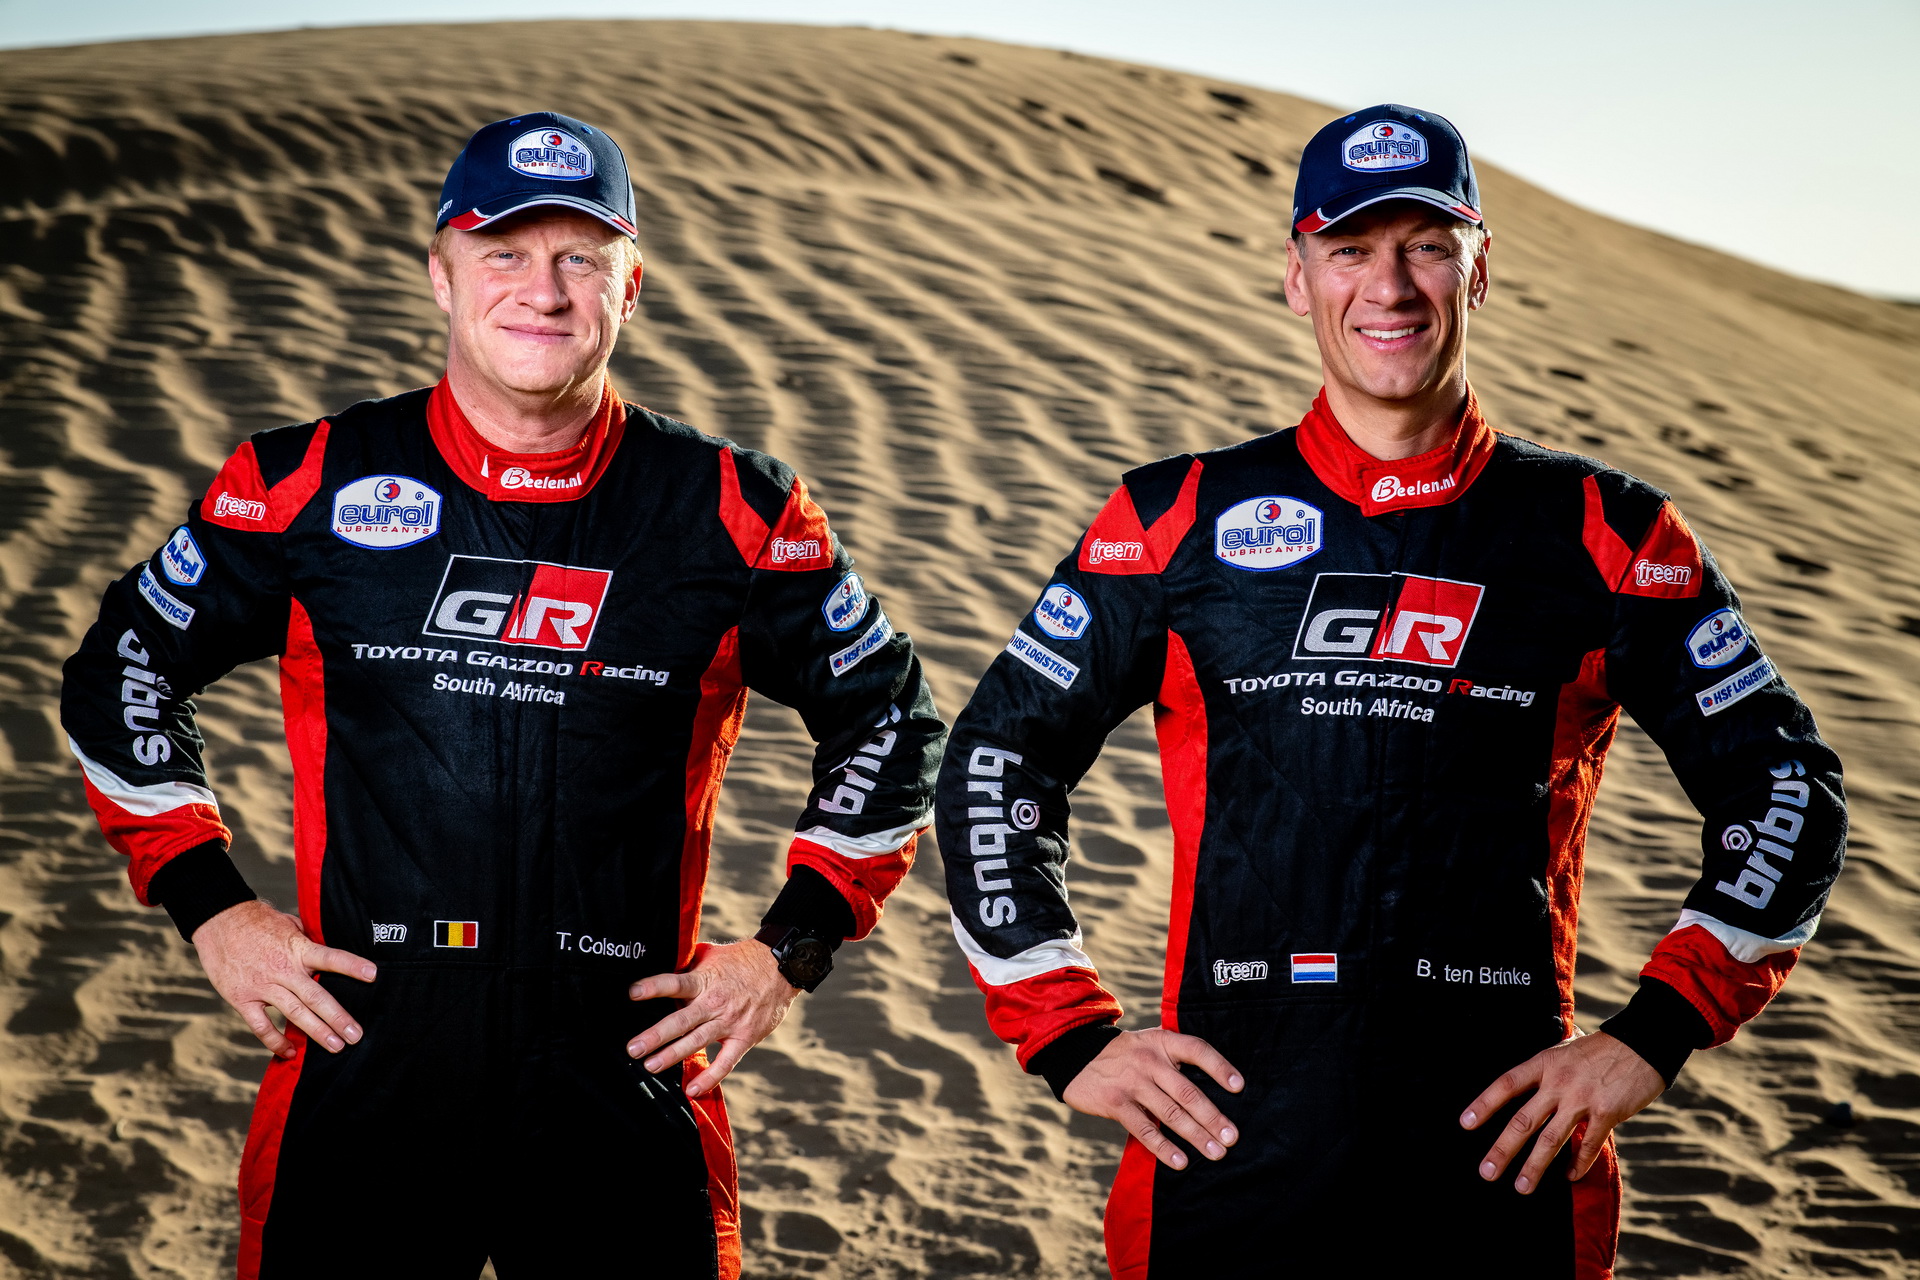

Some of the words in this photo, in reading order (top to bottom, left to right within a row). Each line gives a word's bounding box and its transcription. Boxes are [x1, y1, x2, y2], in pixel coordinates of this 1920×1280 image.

[515, 147, 587, 170] eurol
[1348, 138, 1421, 160] eurol
[1349, 153, 1421, 166] LUBRICANTS
[516, 162, 587, 176] LUBRICANTS
[500, 467, 583, 489] Beelen.nl
[1371, 473, 1457, 502] Beelen.nl
[214, 491, 266, 521] freem
[338, 500, 433, 527] eurol
[336, 526, 431, 535] LUBRICANTS
[1221, 518, 1316, 549] eurol
[771, 537, 821, 563] freem
[1088, 538, 1144, 565] freem
[1220, 545, 1315, 558] LUBRICANTS
[1635, 559, 1692, 586] freem
[148, 584, 191, 623] LOGISTICS
[1040, 599, 1084, 633] eurol
[434, 590, 594, 645] GR
[1304, 608, 1464, 661] GR
[1696, 620, 1745, 660] eurol
[351, 644, 458, 663] TOYOTA
[579, 660, 670, 687] Racing
[843, 644, 862, 666] HSF
[1010, 636, 1029, 652] HSF
[1024, 645, 1075, 682] LOGISTICS
[432, 672, 496, 696] South
[1223, 671, 1326, 695] TOYOTA
[1447, 678, 1536, 707] Racing
[1713, 684, 1735, 705] HSF
[1301, 697, 1362, 716] South
[967, 746, 1024, 928] bribus
[556, 931, 572, 951] T.
[1213, 959, 1268, 986] freem
[1416, 958, 1437, 978] B.
[1443, 963, 1474, 984] ten
[1479, 966, 1532, 986] Brinke
